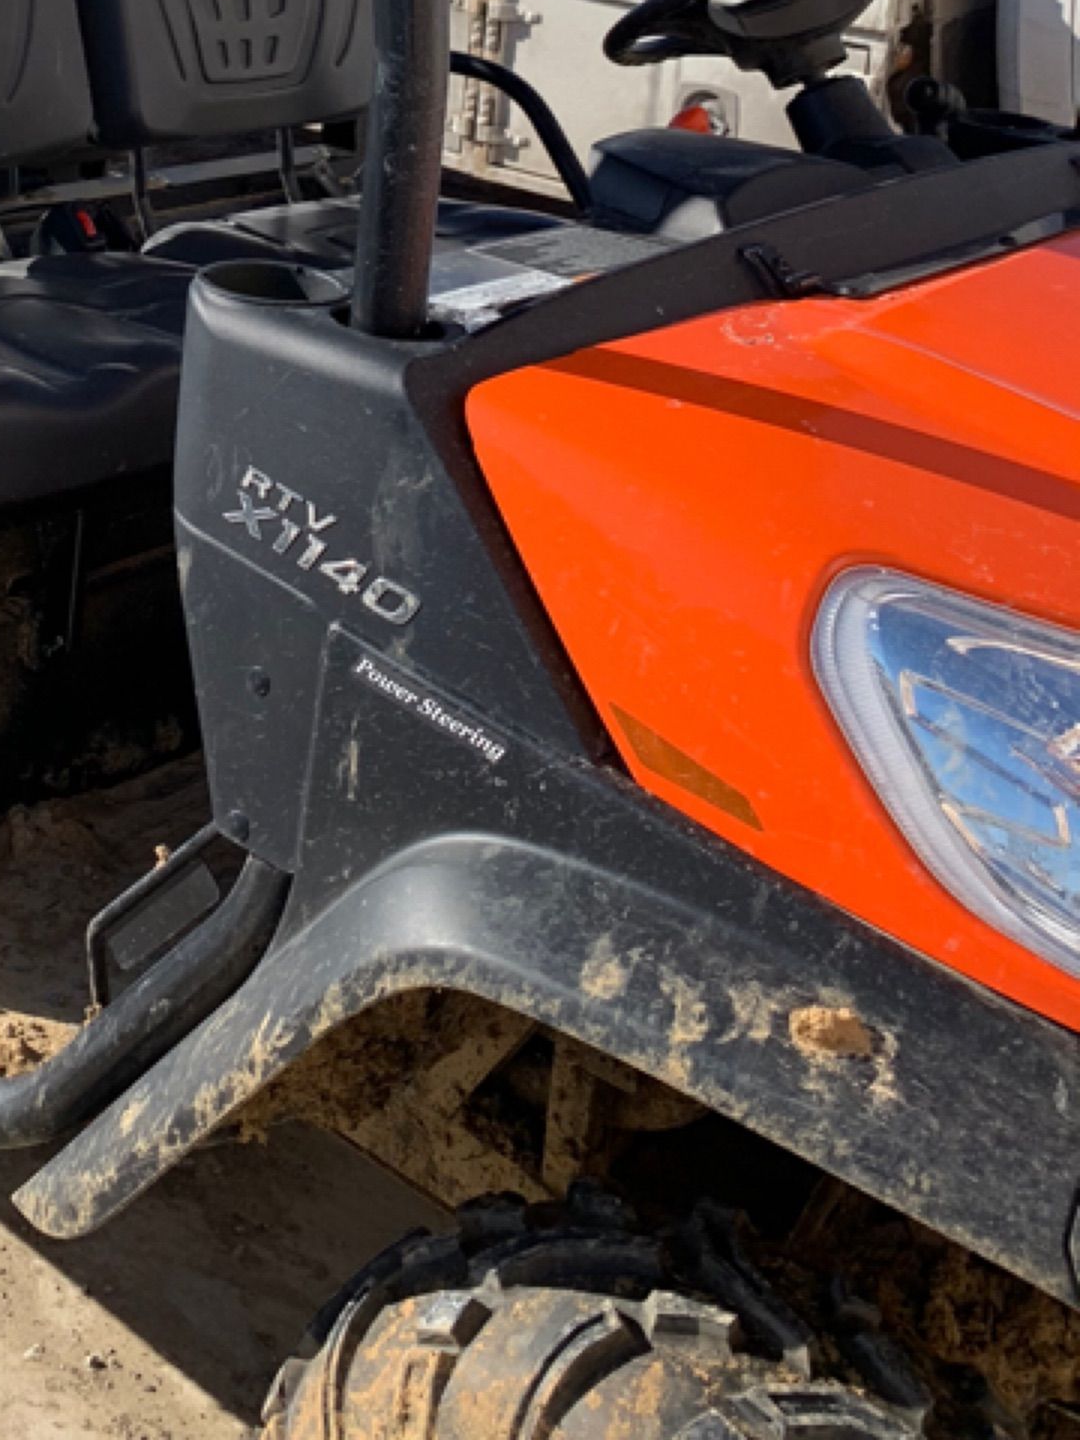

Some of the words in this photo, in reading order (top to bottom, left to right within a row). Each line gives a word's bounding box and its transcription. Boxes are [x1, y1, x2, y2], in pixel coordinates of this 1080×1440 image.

[241, 465, 337, 532] RTV
[222, 489, 421, 626] X1140
[356, 658, 418, 703] Power
[417, 698, 506, 764] Steering
